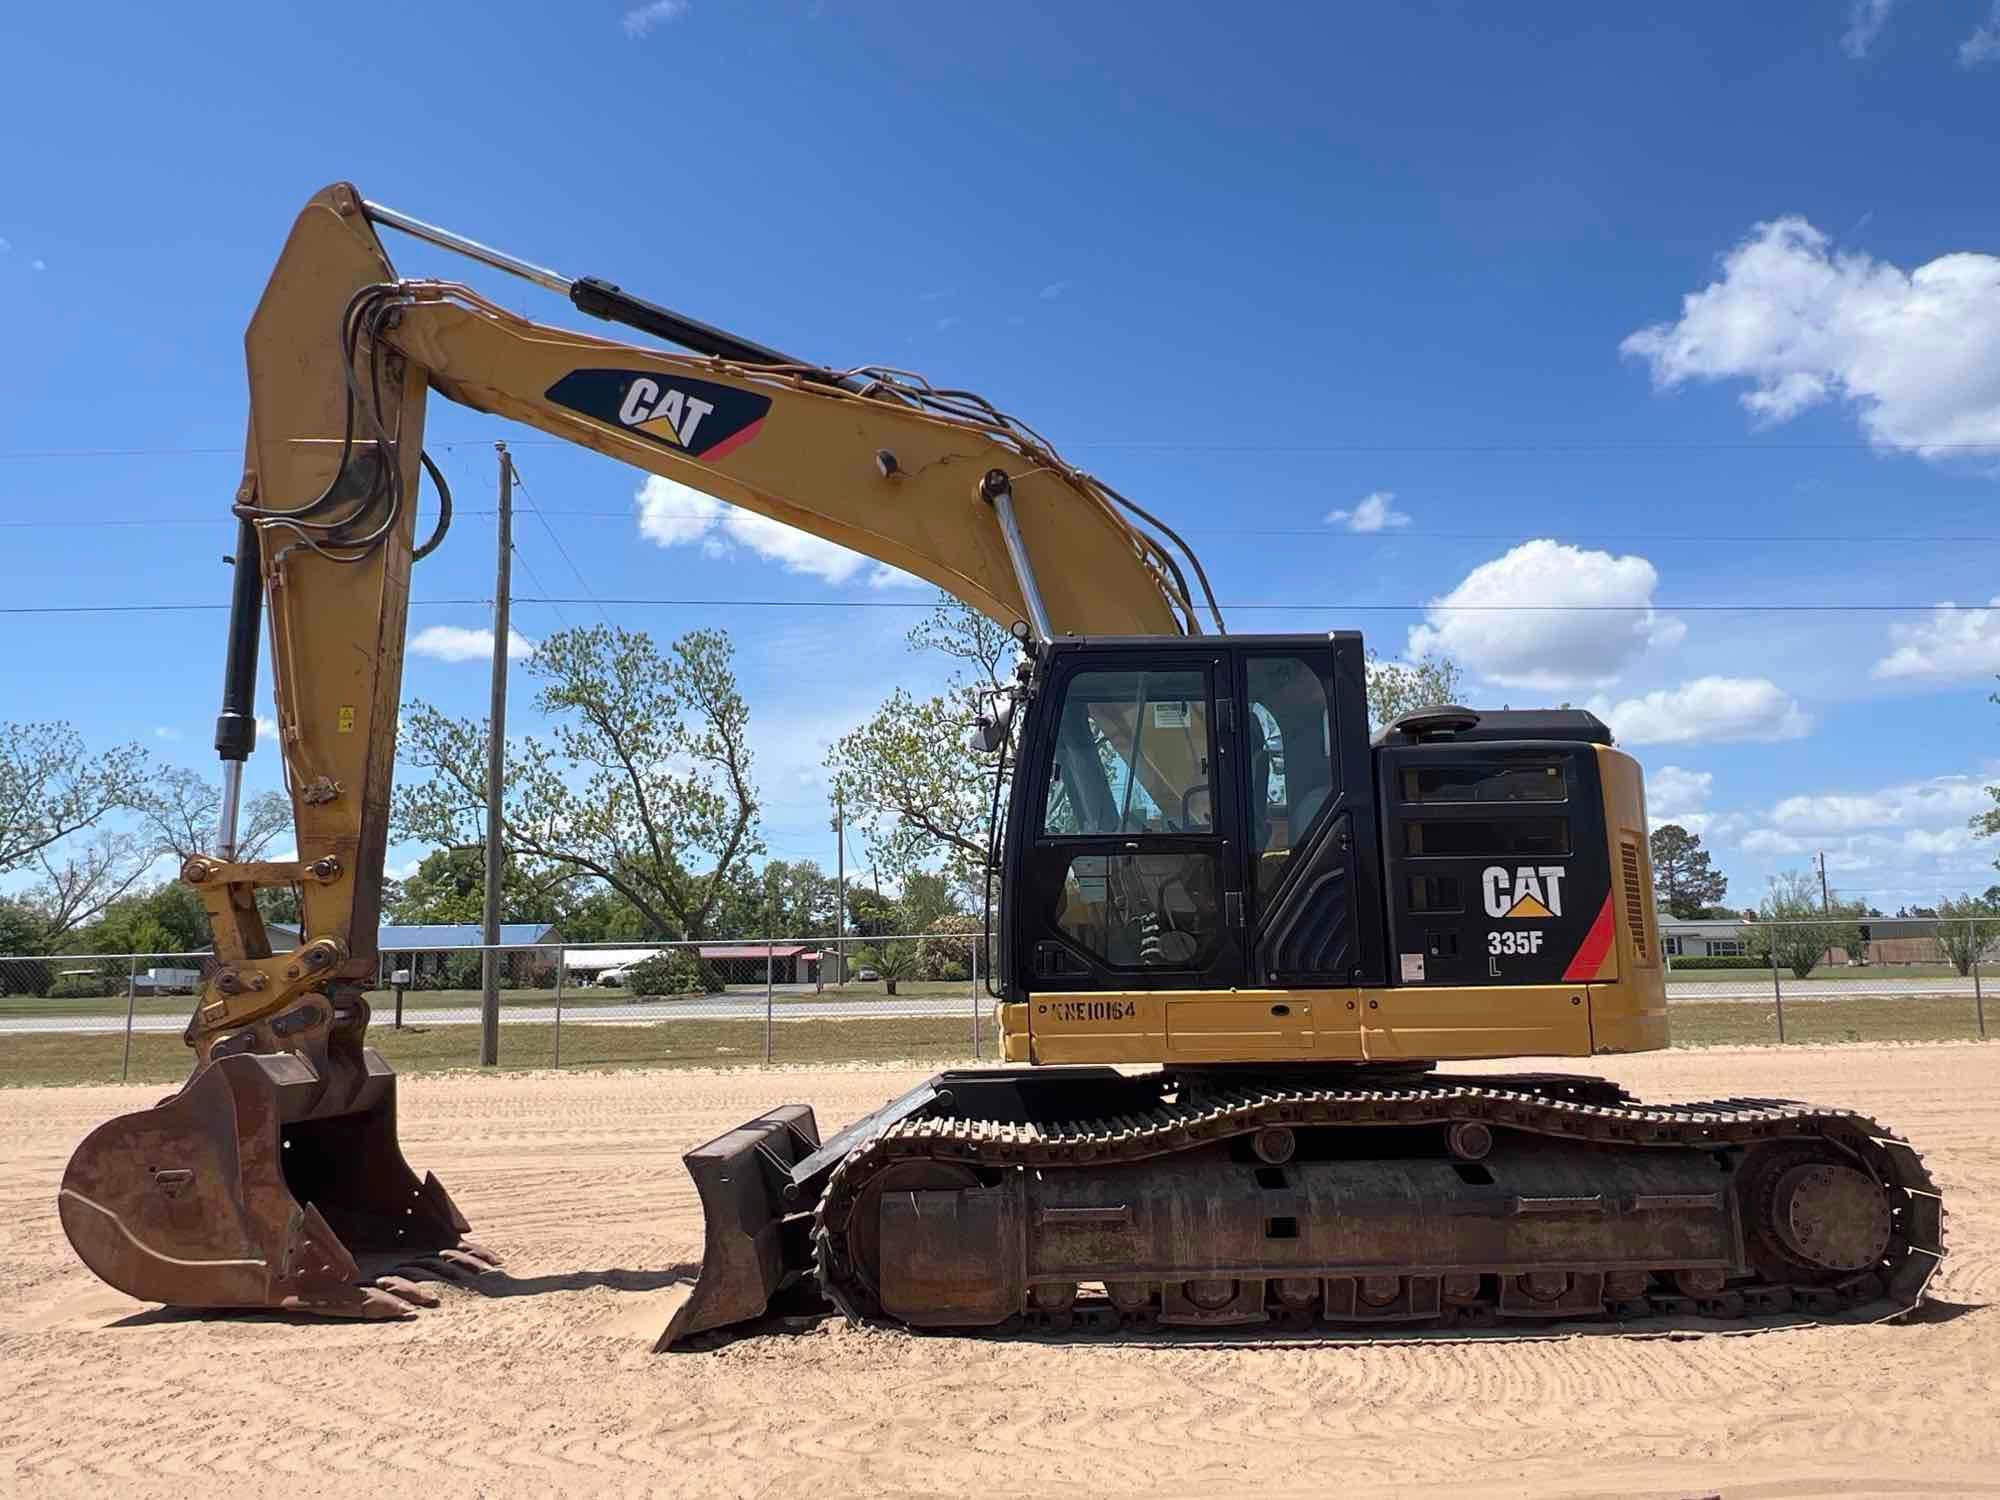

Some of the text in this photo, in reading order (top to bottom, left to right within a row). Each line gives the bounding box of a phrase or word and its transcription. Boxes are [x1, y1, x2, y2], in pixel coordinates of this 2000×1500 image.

[619, 378, 714, 448] CAT
[1482, 866, 1565, 918] CAT
[1487, 931, 1543, 955] 335F
[1489, 956, 1502, 977] L
